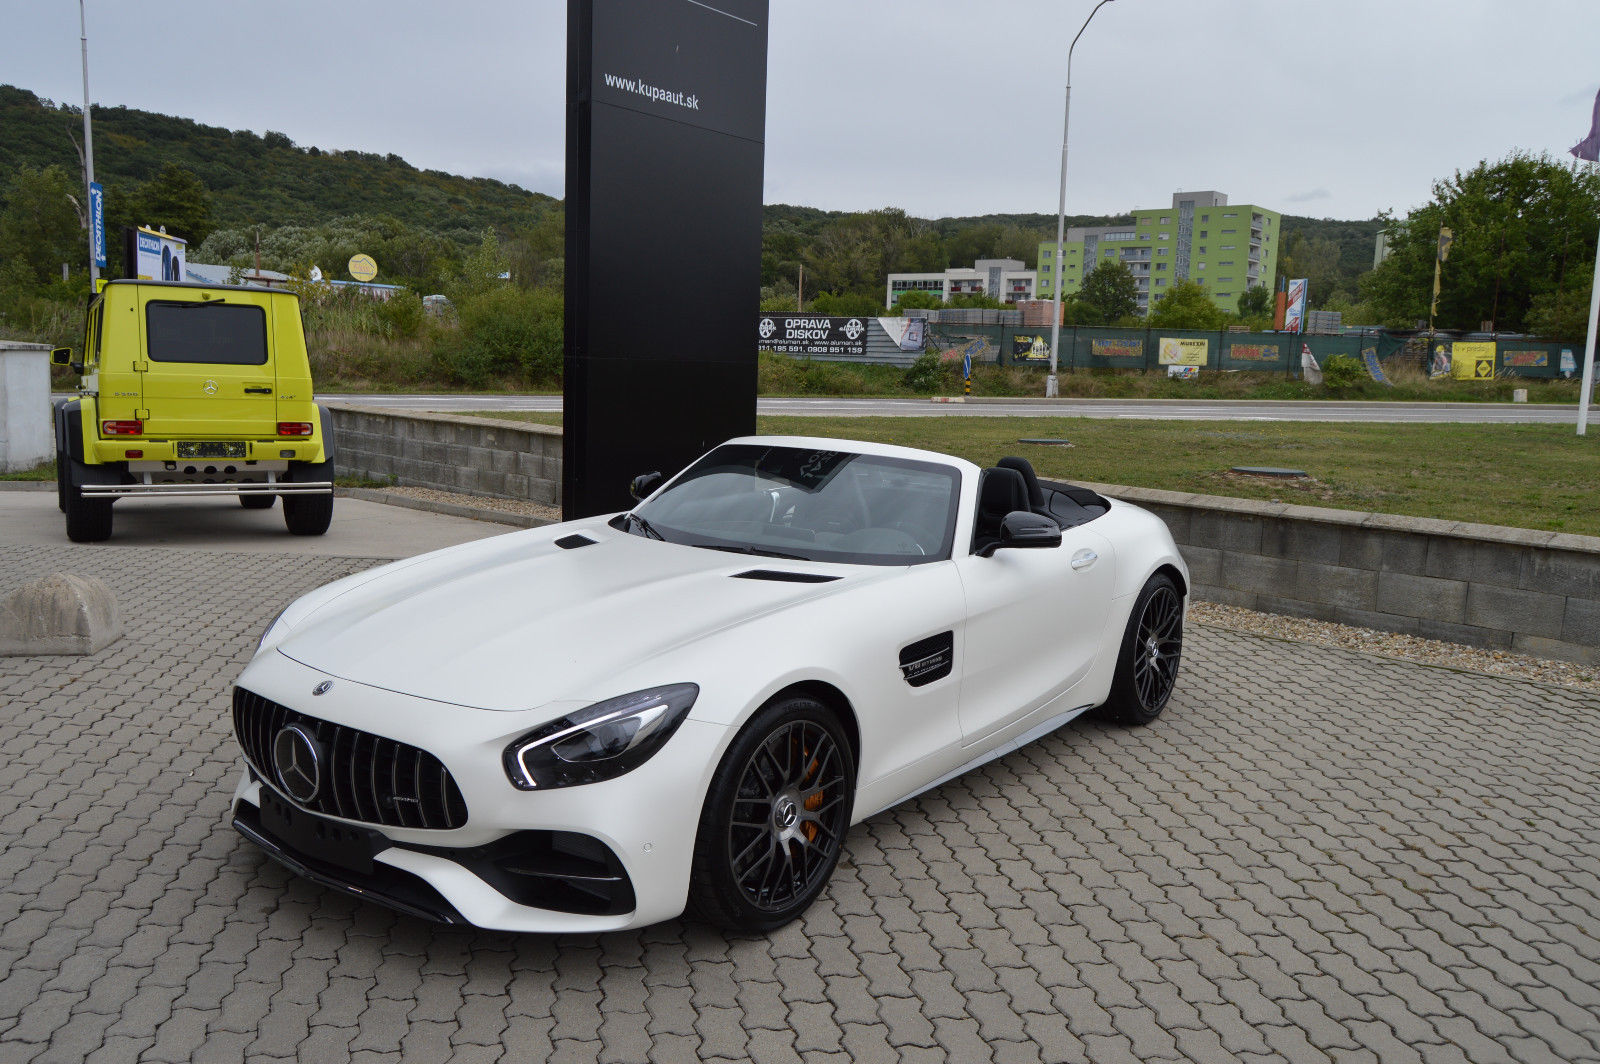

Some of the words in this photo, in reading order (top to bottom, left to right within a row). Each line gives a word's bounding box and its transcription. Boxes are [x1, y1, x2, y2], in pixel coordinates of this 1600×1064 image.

[604, 73, 699, 110] www.kupaaut.sk
[95, 189, 103, 262] DECATHLON
[140, 236, 161, 251] DECATHLON
[785, 319, 831, 329] OPRAVA
[786, 329, 829, 340] DISKOV
